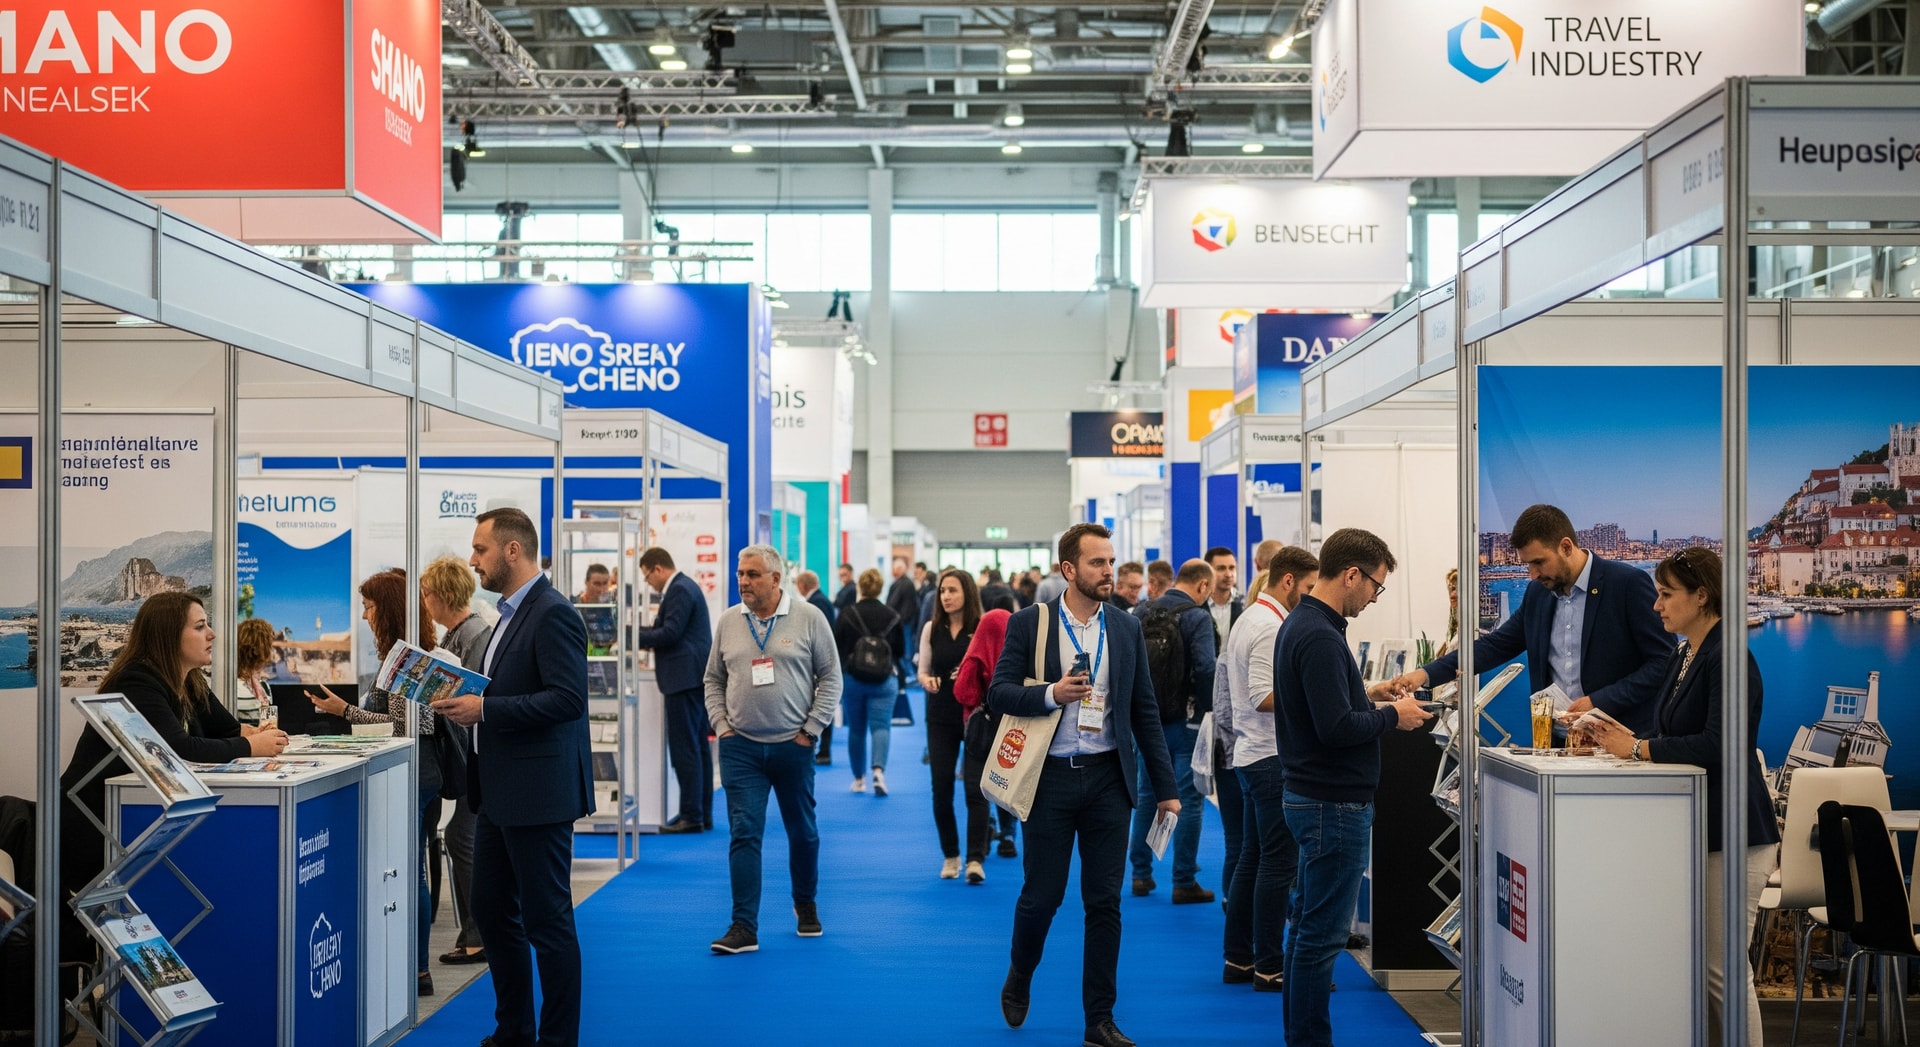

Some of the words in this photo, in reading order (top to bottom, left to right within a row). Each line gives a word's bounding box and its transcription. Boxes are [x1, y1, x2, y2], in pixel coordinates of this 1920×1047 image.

[1544, 16, 1662, 42] TRAVEL
[370, 27, 426, 123] SHANO
[1530, 50, 1703, 77] INDUESTRY
[3, 86, 151, 113] NEALSEK
[1254, 223, 1380, 244] BENSECHT
[577, 366, 681, 392] CHENO
